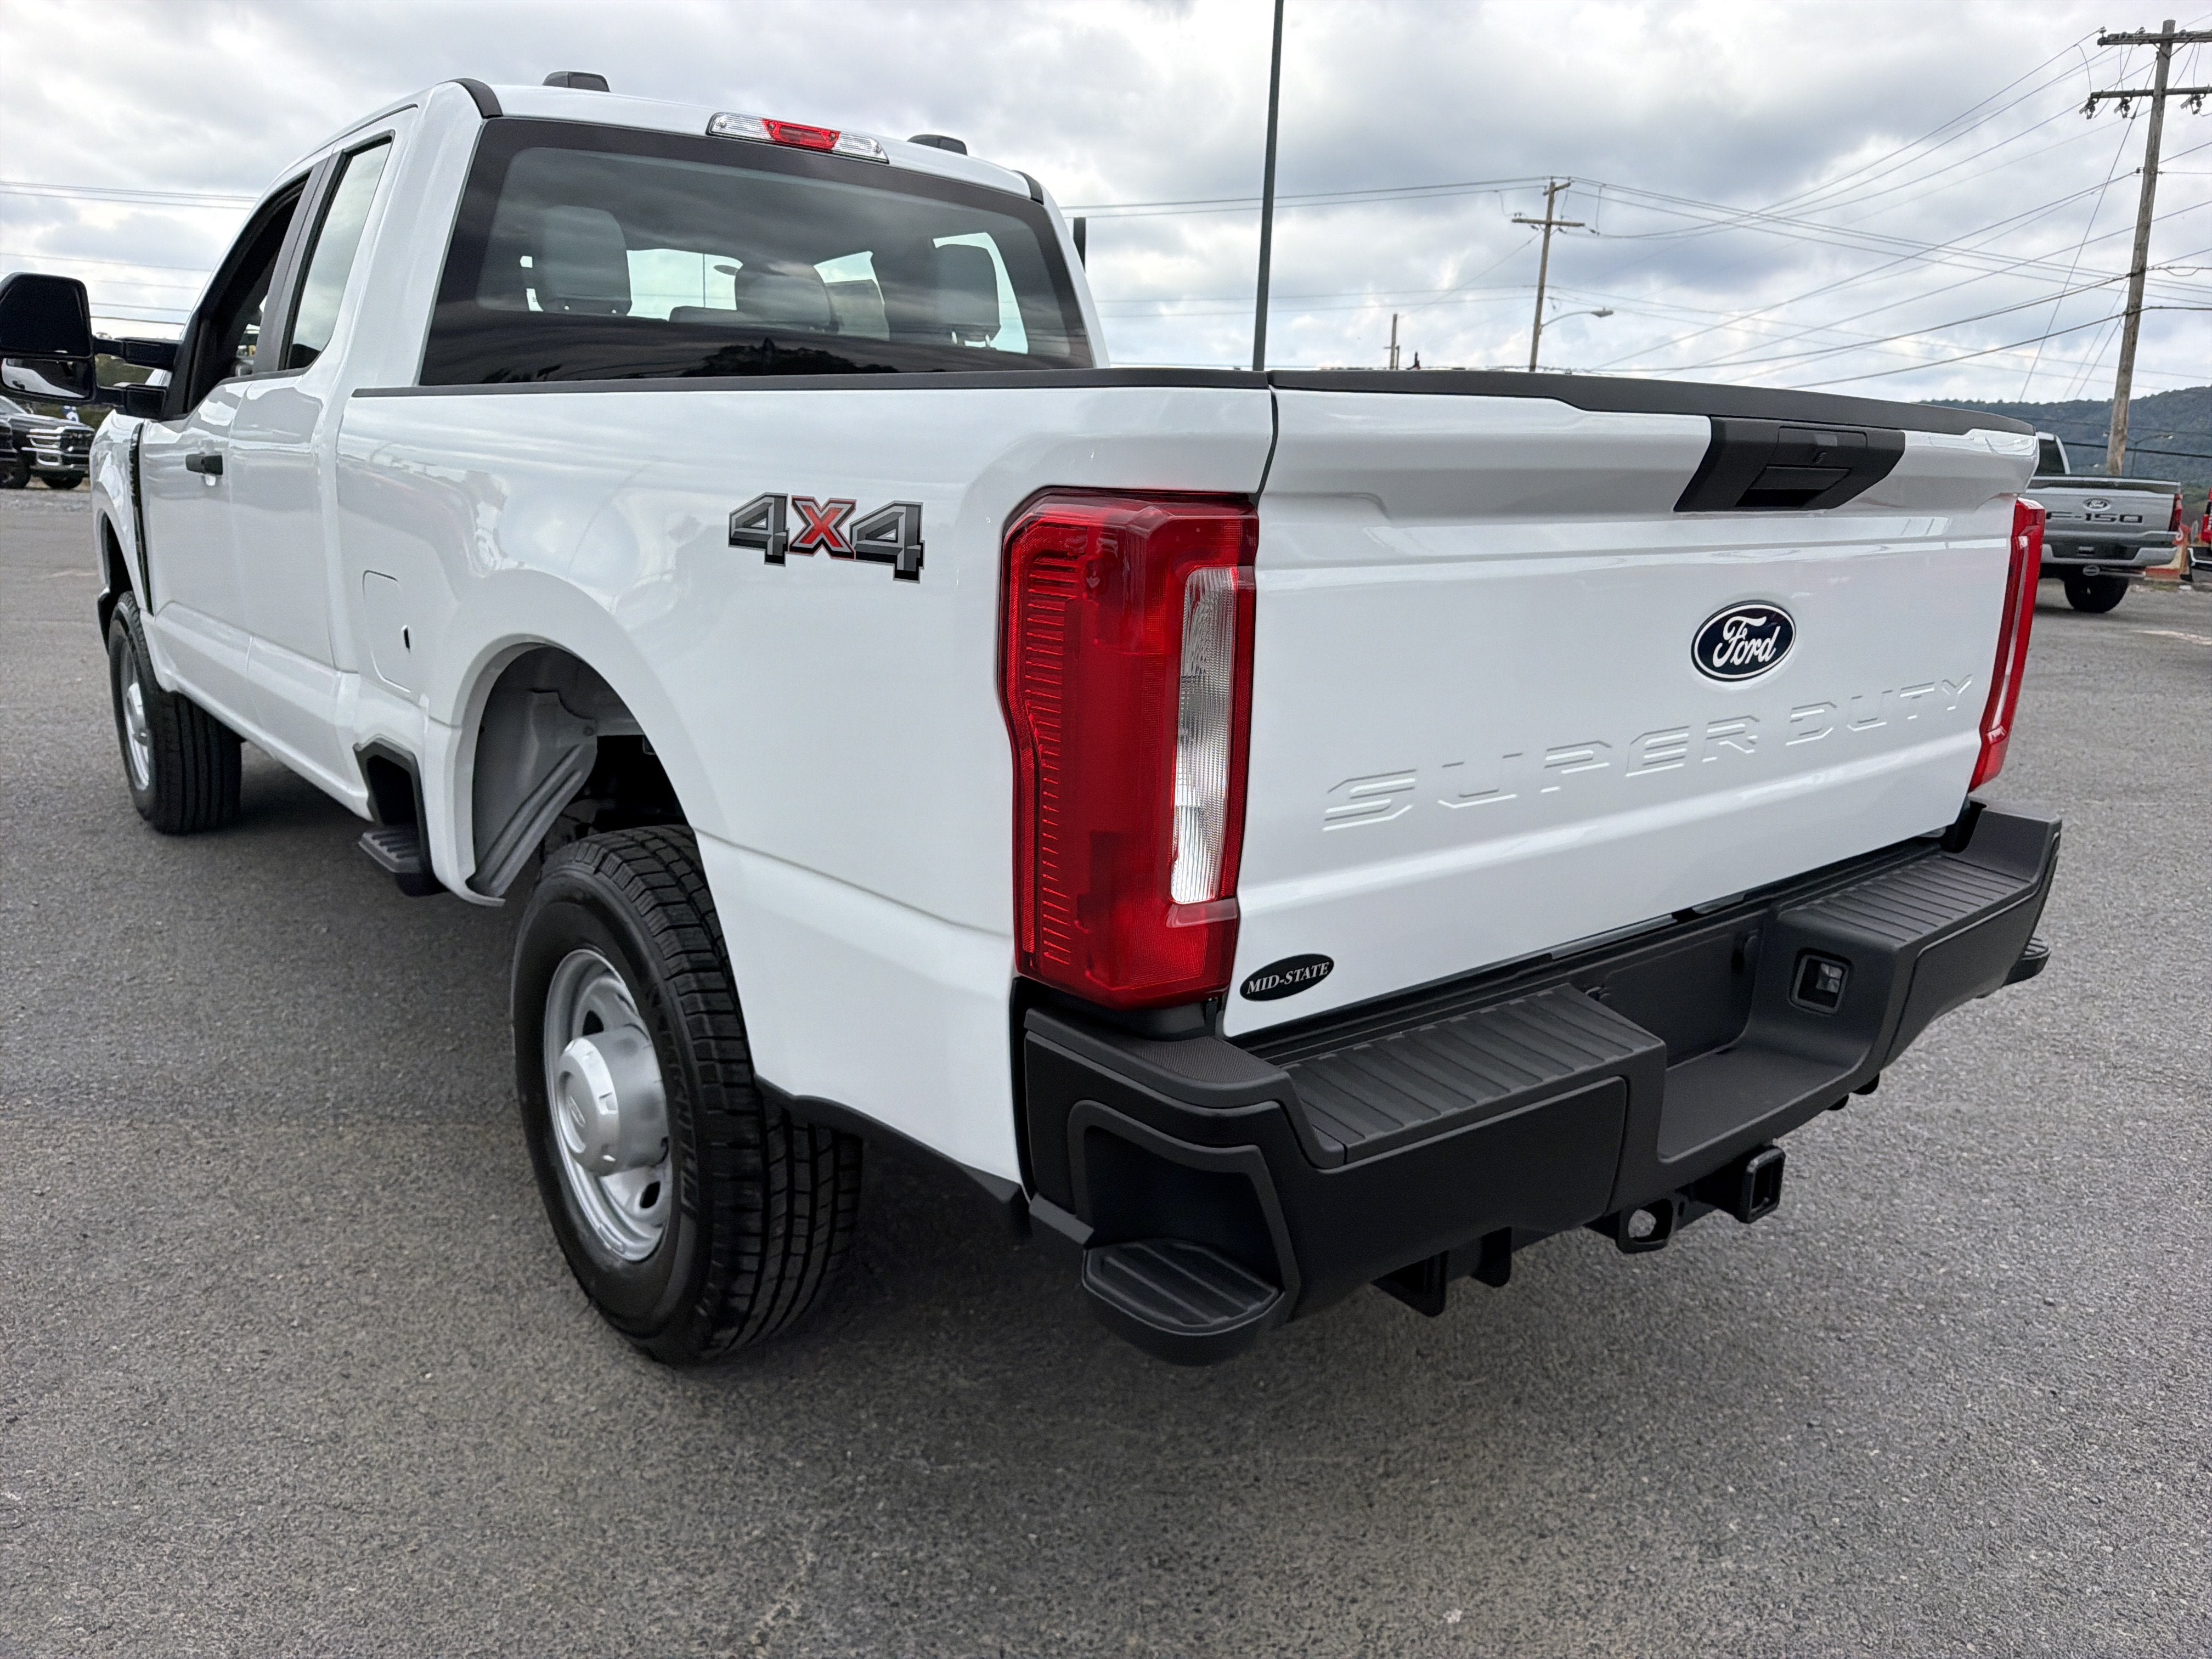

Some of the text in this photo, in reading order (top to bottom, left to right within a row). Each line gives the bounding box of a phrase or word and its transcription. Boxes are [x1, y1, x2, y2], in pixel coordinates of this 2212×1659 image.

[728, 492, 925, 584] 4X4
[2046, 511, 2143, 523] F-150
[1712, 616, 1781, 668] Ford
[1323, 674, 1972, 832] SUPER DUTY
[1246, 962, 1329, 995] MID-STATE
